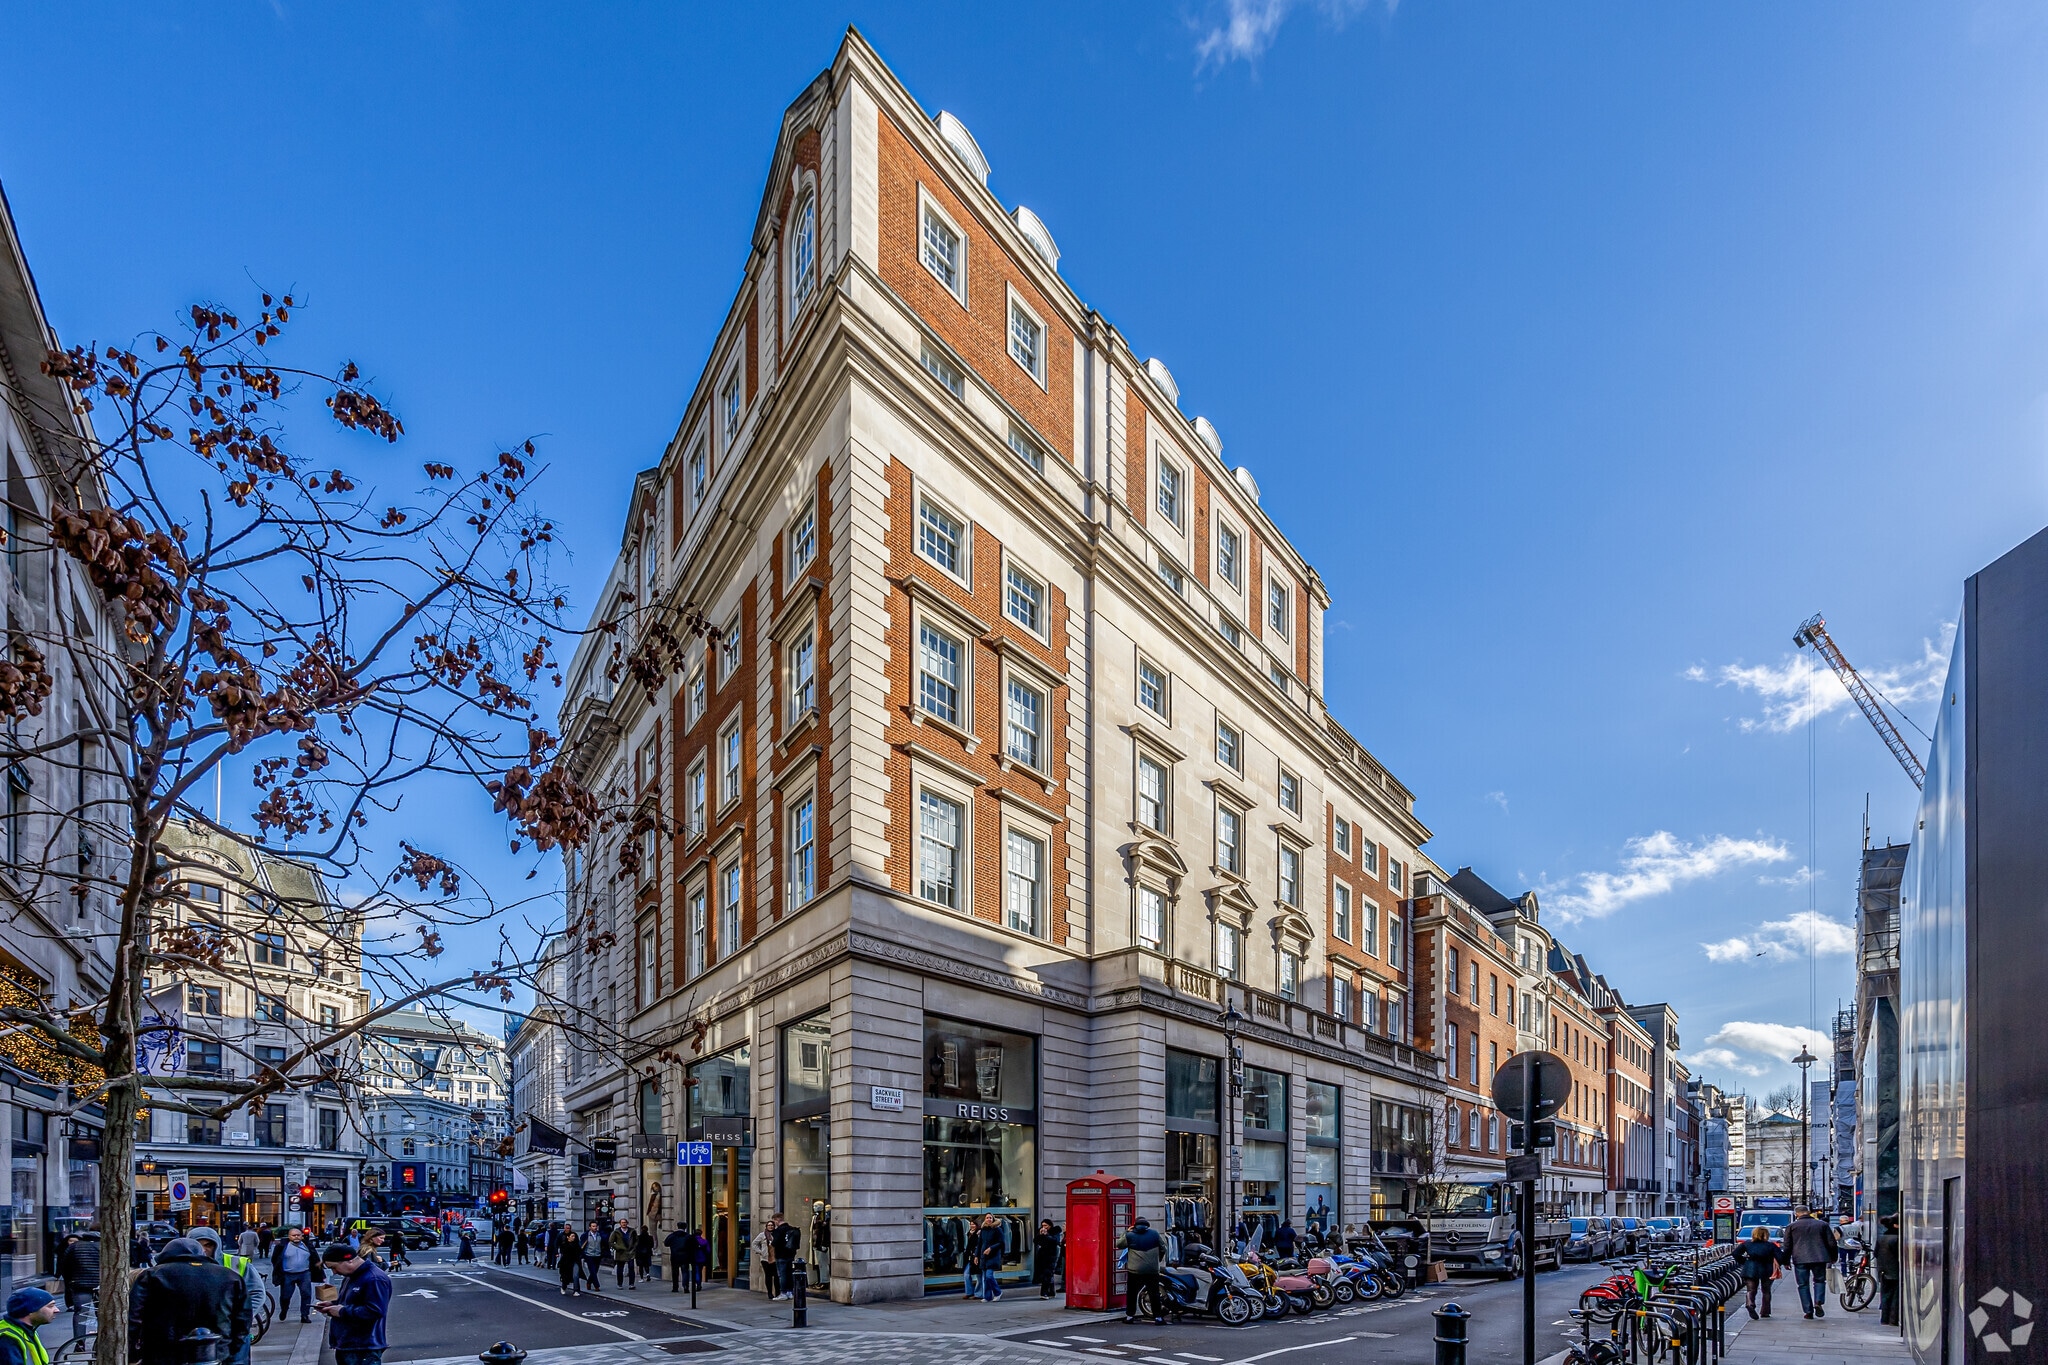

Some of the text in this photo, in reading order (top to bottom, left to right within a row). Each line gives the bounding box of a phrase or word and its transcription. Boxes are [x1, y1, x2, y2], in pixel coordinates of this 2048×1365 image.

[875, 1088, 901, 1098] SACKVILLE
[875, 1095, 901, 1105] STREET W1
[958, 1103, 1009, 1121] REISS
[706, 1133, 741, 1141] REISS
[531, 1145, 561, 1155] Theory
